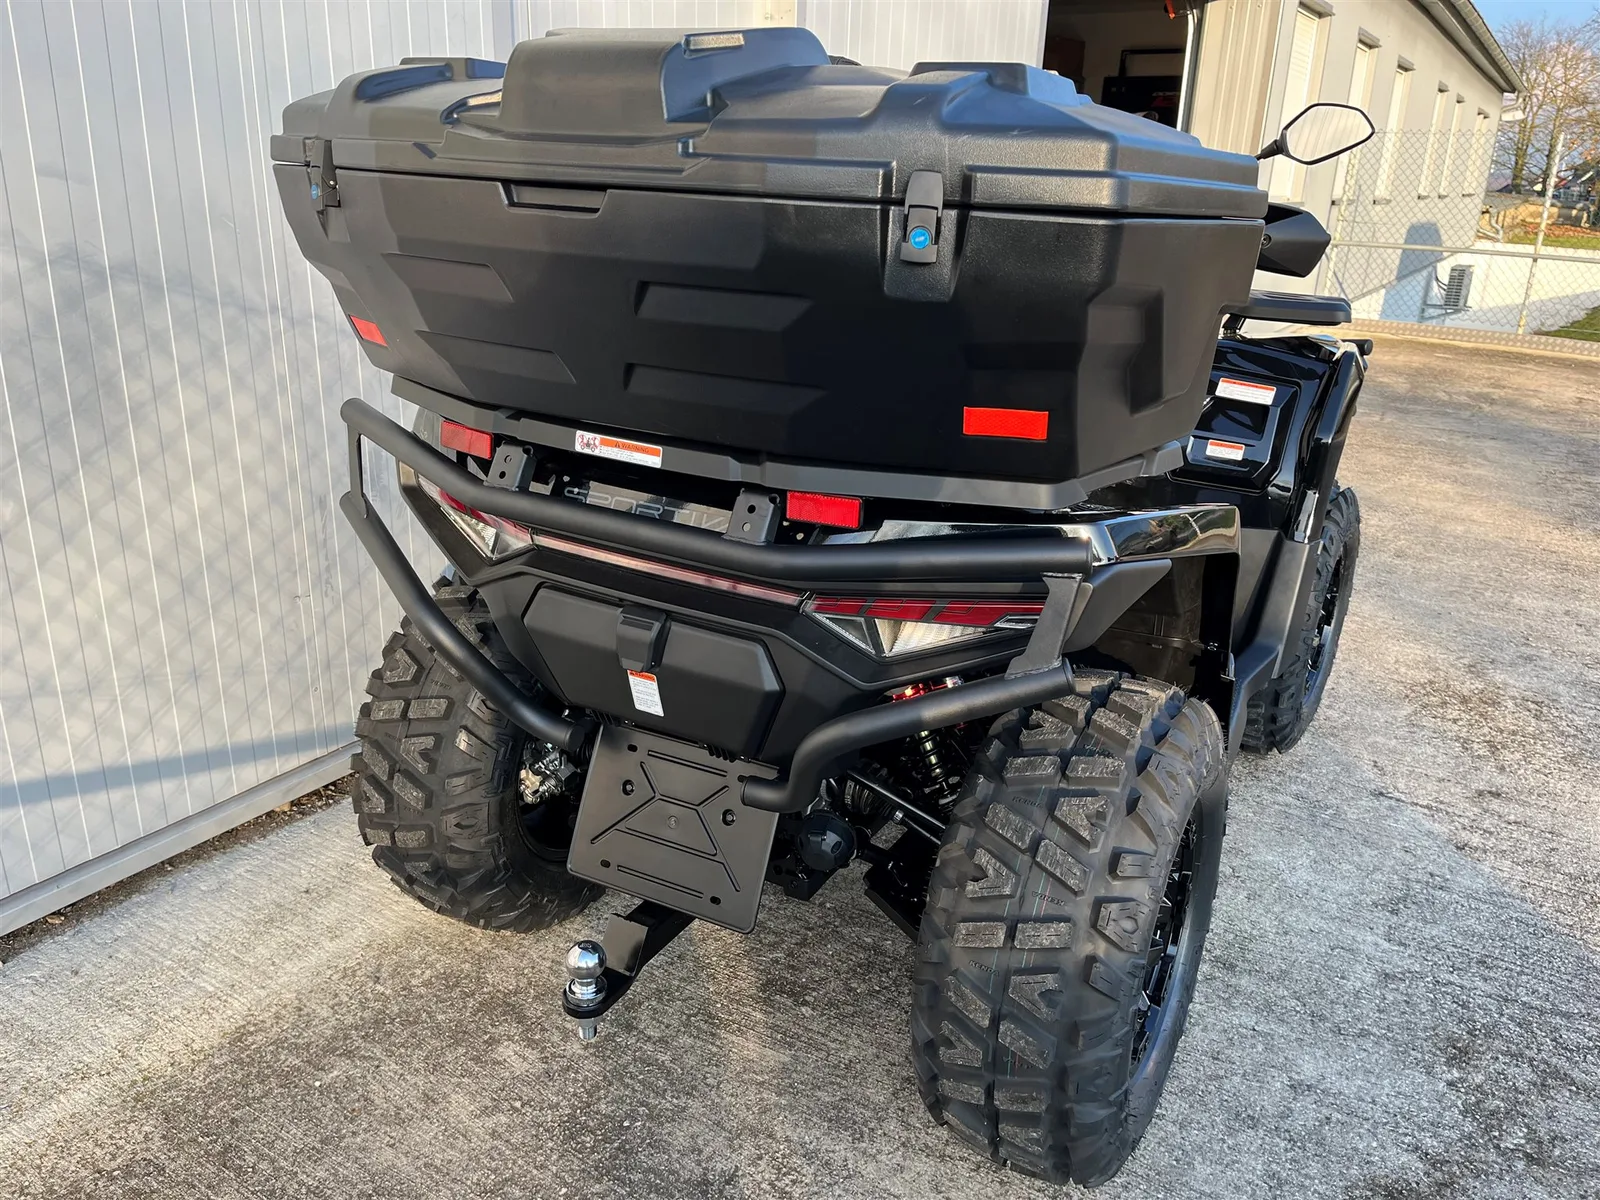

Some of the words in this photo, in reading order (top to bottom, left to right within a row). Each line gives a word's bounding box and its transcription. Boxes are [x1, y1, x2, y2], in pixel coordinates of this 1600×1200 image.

[622, 443, 650, 453] WARNING
[564, 487, 728, 533] SPORTIV
[969, 960, 1000, 977] KENDA
